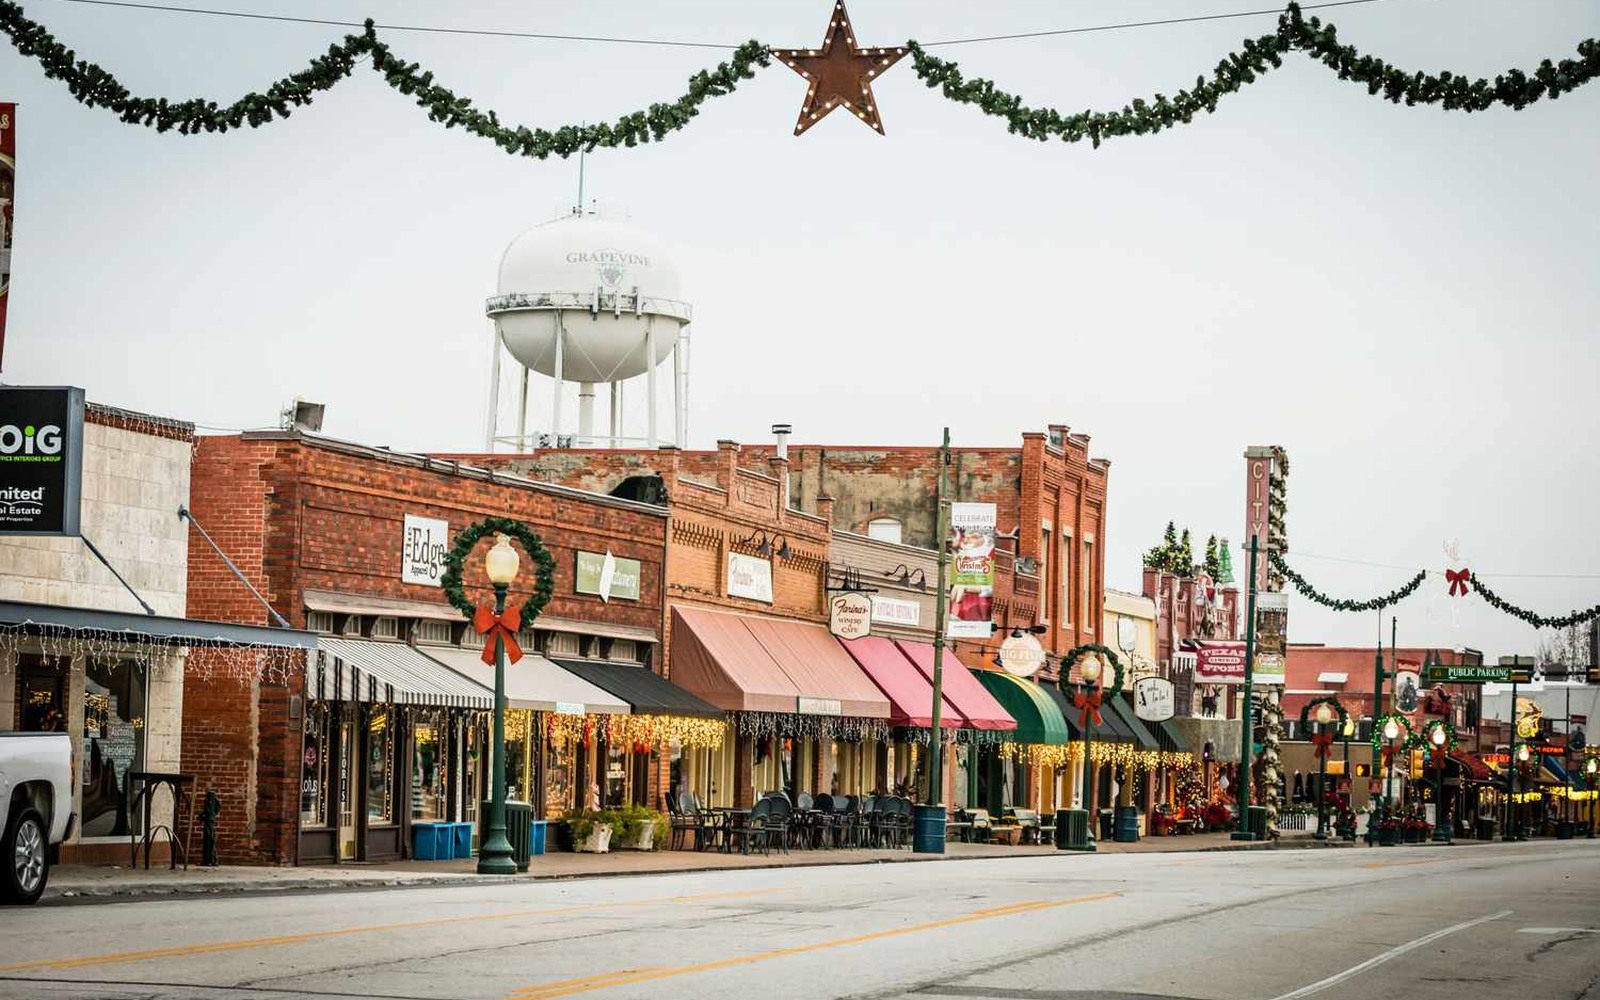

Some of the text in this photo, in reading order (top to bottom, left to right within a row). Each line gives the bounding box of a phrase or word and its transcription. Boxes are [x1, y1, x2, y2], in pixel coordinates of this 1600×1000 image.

[566, 251, 650, 266] GRAPEVINE
[1252, 462, 1263, 536] CITY
[9, 507, 41, 515] Estate
[412, 527, 445, 579] Edge
[834, 599, 868, 616] Farina's
[1201, 648, 1246, 657] TEXAS
[1202, 664, 1245, 672] STORE
[1448, 667, 1509, 677] PUBLIC PARKING
